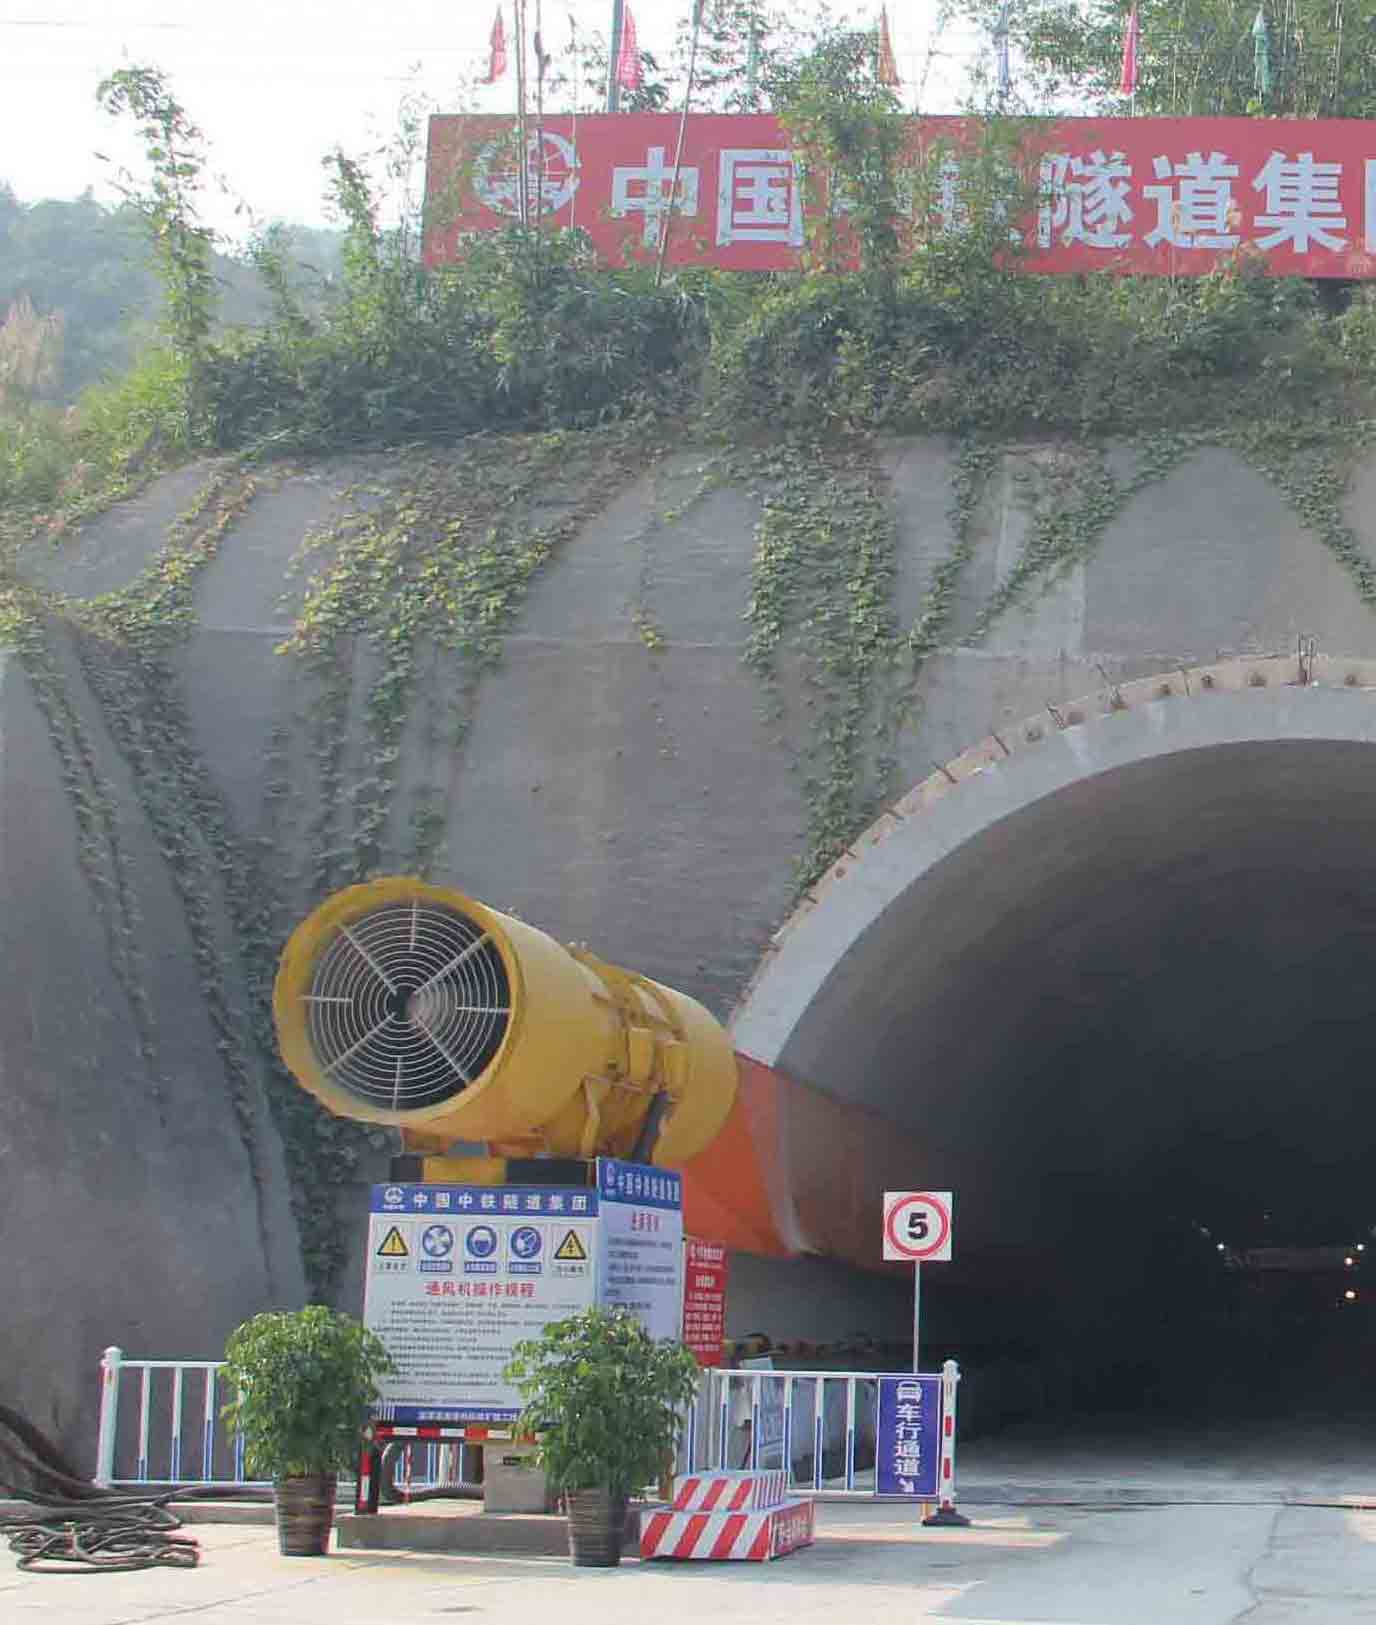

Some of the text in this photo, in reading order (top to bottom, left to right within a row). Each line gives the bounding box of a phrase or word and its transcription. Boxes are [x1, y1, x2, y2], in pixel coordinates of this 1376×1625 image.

[907, 1212, 929, 1240] 5
[425, 1281, 536, 1298] 通风机操作规程
